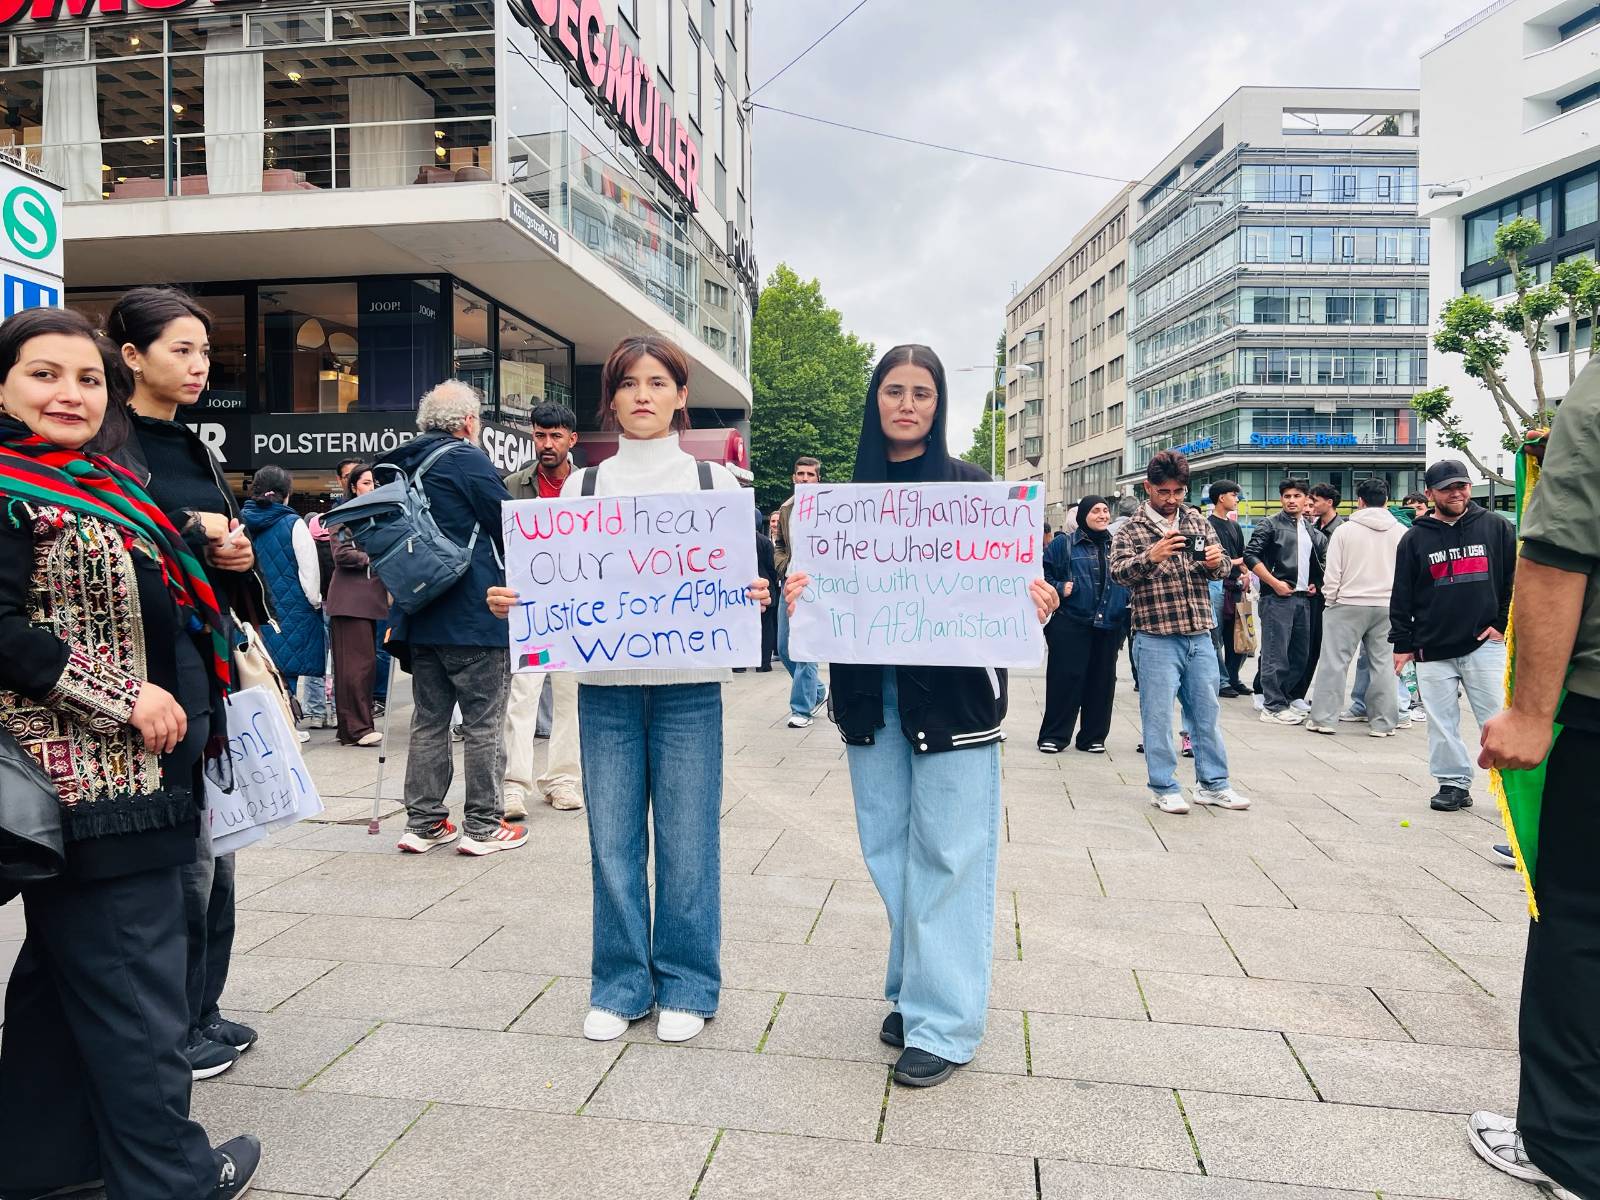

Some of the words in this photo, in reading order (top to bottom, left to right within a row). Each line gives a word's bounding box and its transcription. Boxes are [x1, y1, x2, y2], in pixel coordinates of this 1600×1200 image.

[13, 192, 48, 253] S
[513, 201, 549, 240] Königstraße
[369, 301, 401, 312] JOOP!
[419, 304, 436, 319] JOOP!
[206, 398, 241, 408] JOOP!
[482, 426, 537, 473] SEGM
[633, 497, 727, 535] hear
[867, 567, 919, 595] with
[516, 598, 608, 642] Justice
[829, 607, 857, 639] in
[226, 711, 273, 762] Jus
